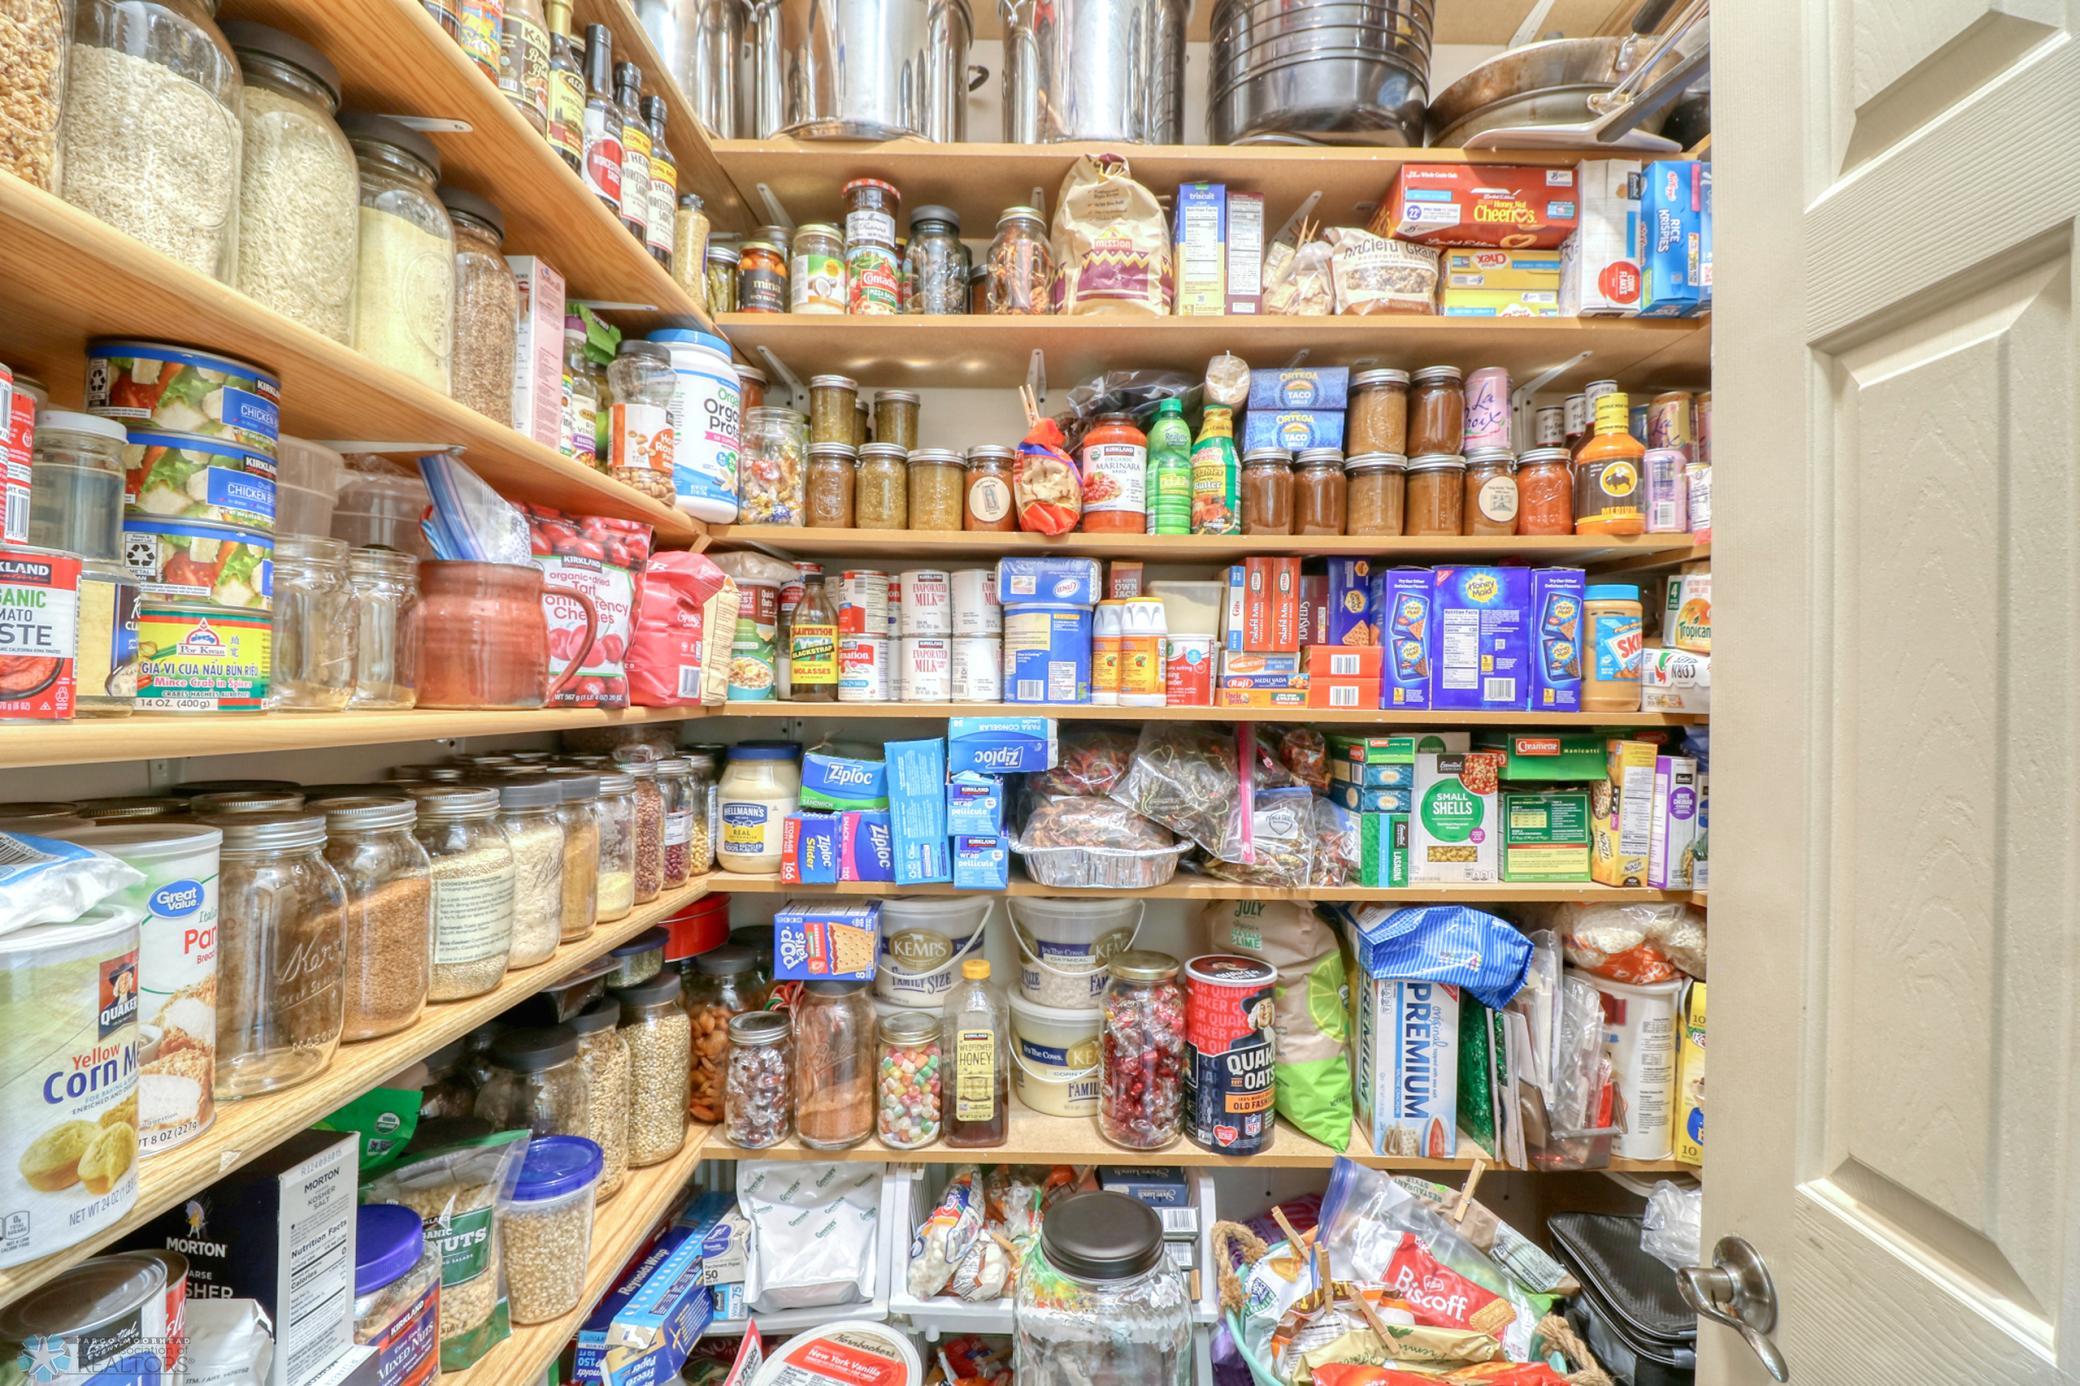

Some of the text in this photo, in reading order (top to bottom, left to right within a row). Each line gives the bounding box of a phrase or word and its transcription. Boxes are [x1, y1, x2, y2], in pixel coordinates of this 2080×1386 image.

[1658, 208, 1670, 253] KRISPIES
[1670, 219, 1681, 243] RICE
[1095, 239, 1132, 249] mission
[1477, 252, 1506, 263] Chex
[753, 278, 782, 292] mina
[1280, 371, 1318, 382] ORTEGA
[1287, 391, 1311, 400] TACO
[1473, 382, 1495, 410] La
[1276, 415, 1314, 425] ORTEGA
[1284, 433, 1307, 442] TACO
[1105, 446, 1134, 455] KIRKLAND
[1096, 460, 1141, 472] MARINARA
[227, 483, 267, 503] CHICKEN
[563, 555, 601, 568] KIRKLAND
[550, 572, 588, 581] organic
[572, 580, 597, 596] Tart
[913, 584, 947, 593] EVAPORATED
[1114, 583, 1137, 591] OWN
[1468, 579, 1494, 592] Honey
[1472, 586, 1493, 597] Maid
[1670, 583, 1678, 598] 4
[915, 593, 938, 606] MILK
[912, 650, 947, 659] EVAPORATED
[178, 663, 199, 675] CUA
[794, 667, 831, 675] MOLASSES
[915, 660, 937, 673] MILK
[1672, 664, 1696, 679] CORN
[153, 676, 187, 687] Mince
[190, 677, 215, 687] Crab
[217, 677, 226, 687] in
[1517, 739, 1558, 753] Creamette
[974, 746, 1019, 766] Ziploc
[829, 764, 874, 786] Ziploc
[1436, 793, 1468, 801] SMALL
[724, 805, 765, 818] HELLMANN'S
[952, 806, 988, 816] pellicule
[1433, 801, 1473, 815] SHELLS
[816, 834, 833, 868] Ziploc
[869, 824, 892, 869] Ziploc
[806, 837, 814, 871] Slider
[958, 860, 994, 868] pellicule
[1393, 851, 1402, 882] LASAGNA
[157, 886, 197, 905] Great
[168, 899, 197, 911] Value
[1234, 899, 1266, 918] JULY
[893, 941, 947, 958] KEMPS
[892, 968, 952, 994] FAMILY SIZE
[1432, 1005, 1448, 1048] original
[72, 1043, 121, 1071] Yellow
[1404, 982, 1432, 1119] PREMIUM
[959, 1052, 992, 1066] HONEY
[43, 1059, 118, 1105] Corn
[72, 1096, 110, 1116] ENRICHED
[1233, 1102, 1250, 1111] OLD
[151, 1134, 157, 1145] 8
[159, 1130, 173, 1141] OZ
[1682, 1146, 1697, 1156] 10
[304, 1167, 340, 1193] MORTON
[69, 1193, 119, 1227] NET WT 24 OZ
[292, 1219, 347, 1259] Nutrition Facts
[166, 1239, 227, 1259] MORTON
[727, 1260, 740, 1269] Paper
[291, 1269, 318, 1290] Calories
[618, 1248, 670, 1297] Reynolds Wrap
[705, 1269, 718, 1280] 50
[732, 1286, 742, 1300] 75
[1396, 1264, 1468, 1322] Biscoff
[391, 1300, 424, 1336] KIRKLAND
[631, 1355, 656, 1373] Paper
[808, 1348, 881, 1377] New York Vanilla
[626, 1368, 655, 1386] Freezer
